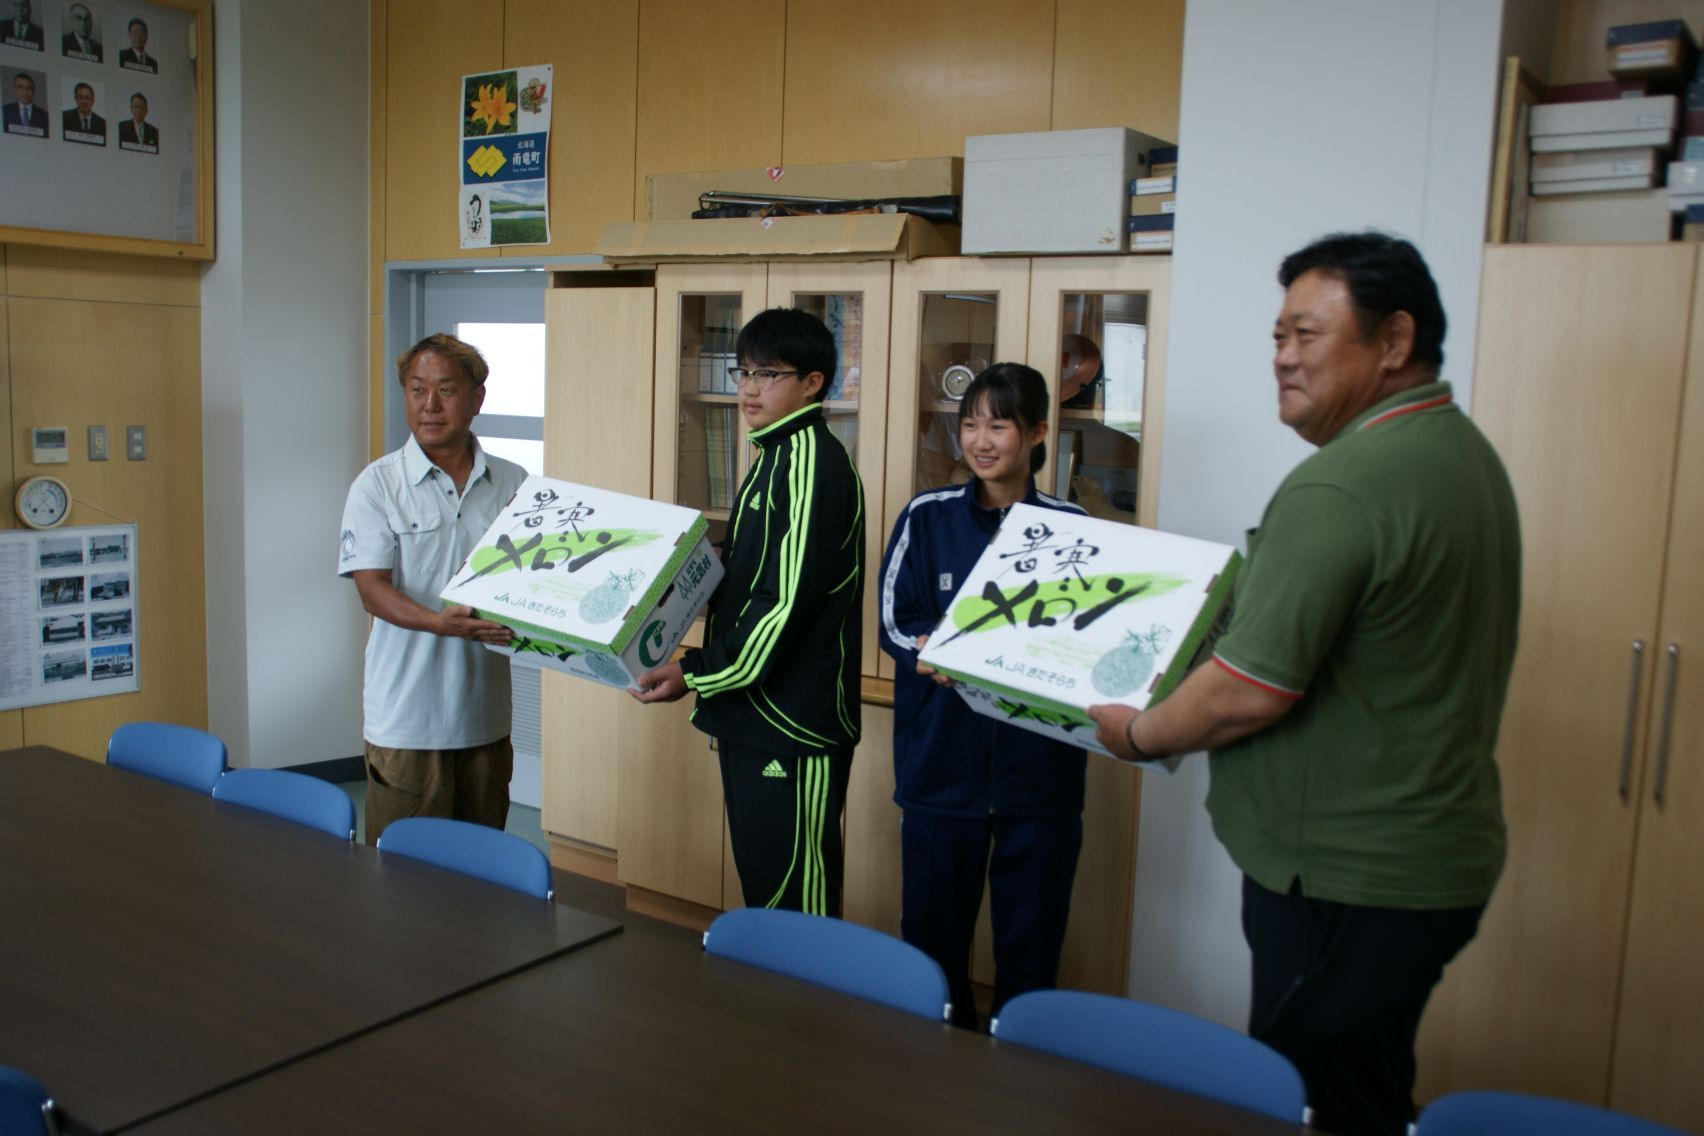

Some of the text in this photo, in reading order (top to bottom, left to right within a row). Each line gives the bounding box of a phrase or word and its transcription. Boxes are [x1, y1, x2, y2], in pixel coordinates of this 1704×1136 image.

[512, 151, 541, 166] 雨竜町
[455, 531, 634, 588] メロン
[935, 577, 1153, 650] メロン
